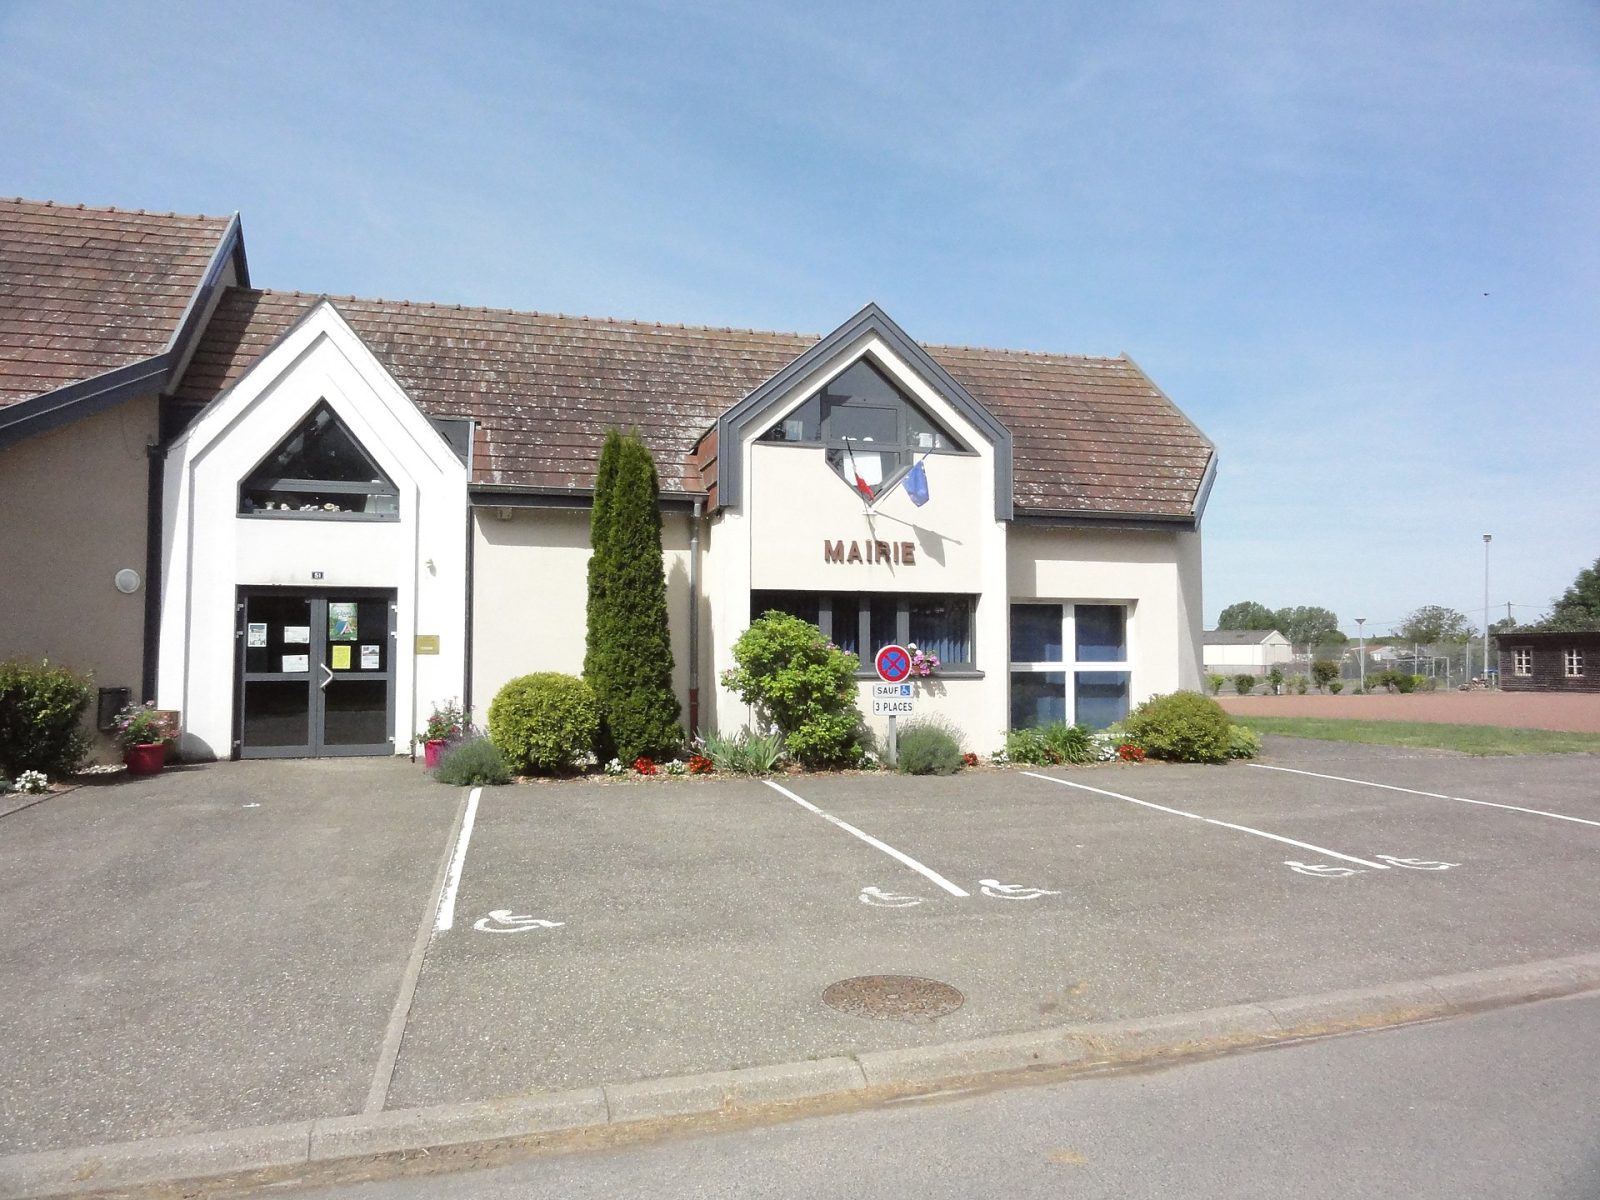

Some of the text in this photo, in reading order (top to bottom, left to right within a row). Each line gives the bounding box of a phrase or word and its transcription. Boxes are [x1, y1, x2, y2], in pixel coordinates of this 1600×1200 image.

[824, 539, 916, 566] MAIRIE
[877, 686, 899, 695] SAUF
[875, 702, 912, 712] 3 PLACES
